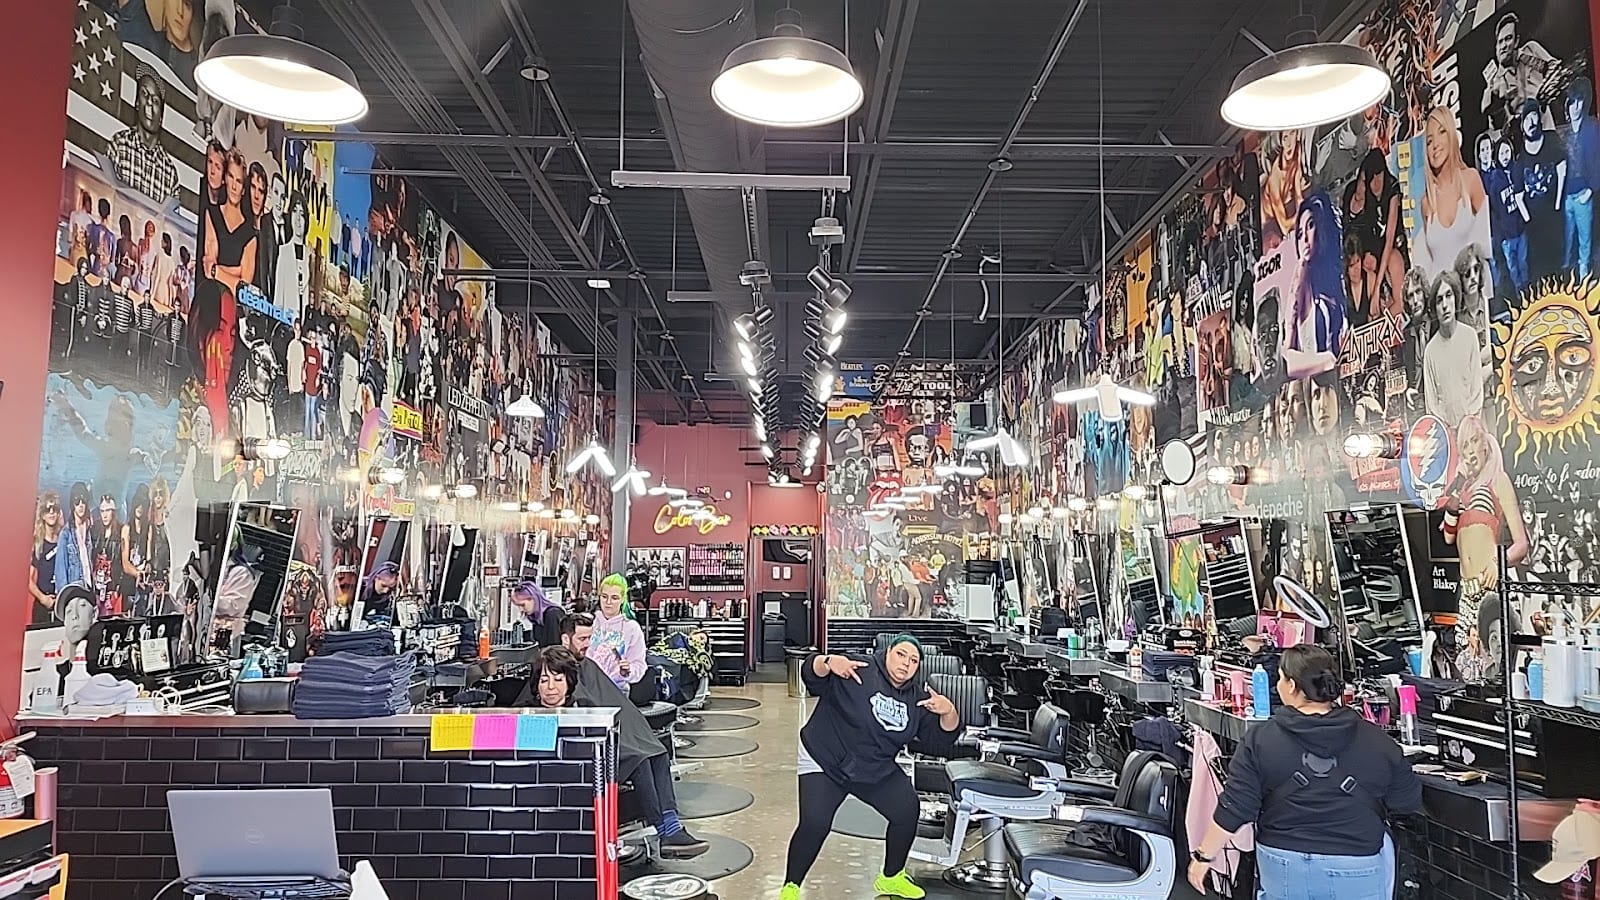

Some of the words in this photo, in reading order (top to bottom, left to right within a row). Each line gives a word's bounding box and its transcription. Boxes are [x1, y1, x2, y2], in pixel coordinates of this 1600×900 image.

[1257, 253, 1281, 281] IGOR
[1336, 308, 1407, 373] ANTHRAX
[921, 382, 952, 390] TOOL
[448, 386, 461, 407] LED
[461, 393, 488, 419] ZEPPELIN
[1547, 467, 1557, 483] to
[908, 514, 928, 522] Live
[1256, 494, 1303, 521] depeche
[653, 503, 693, 534] Color
[698, 505, 731, 534] Bar
[1432, 566, 1446, 577] Art
[1433, 578, 1458, 593] Blakey
